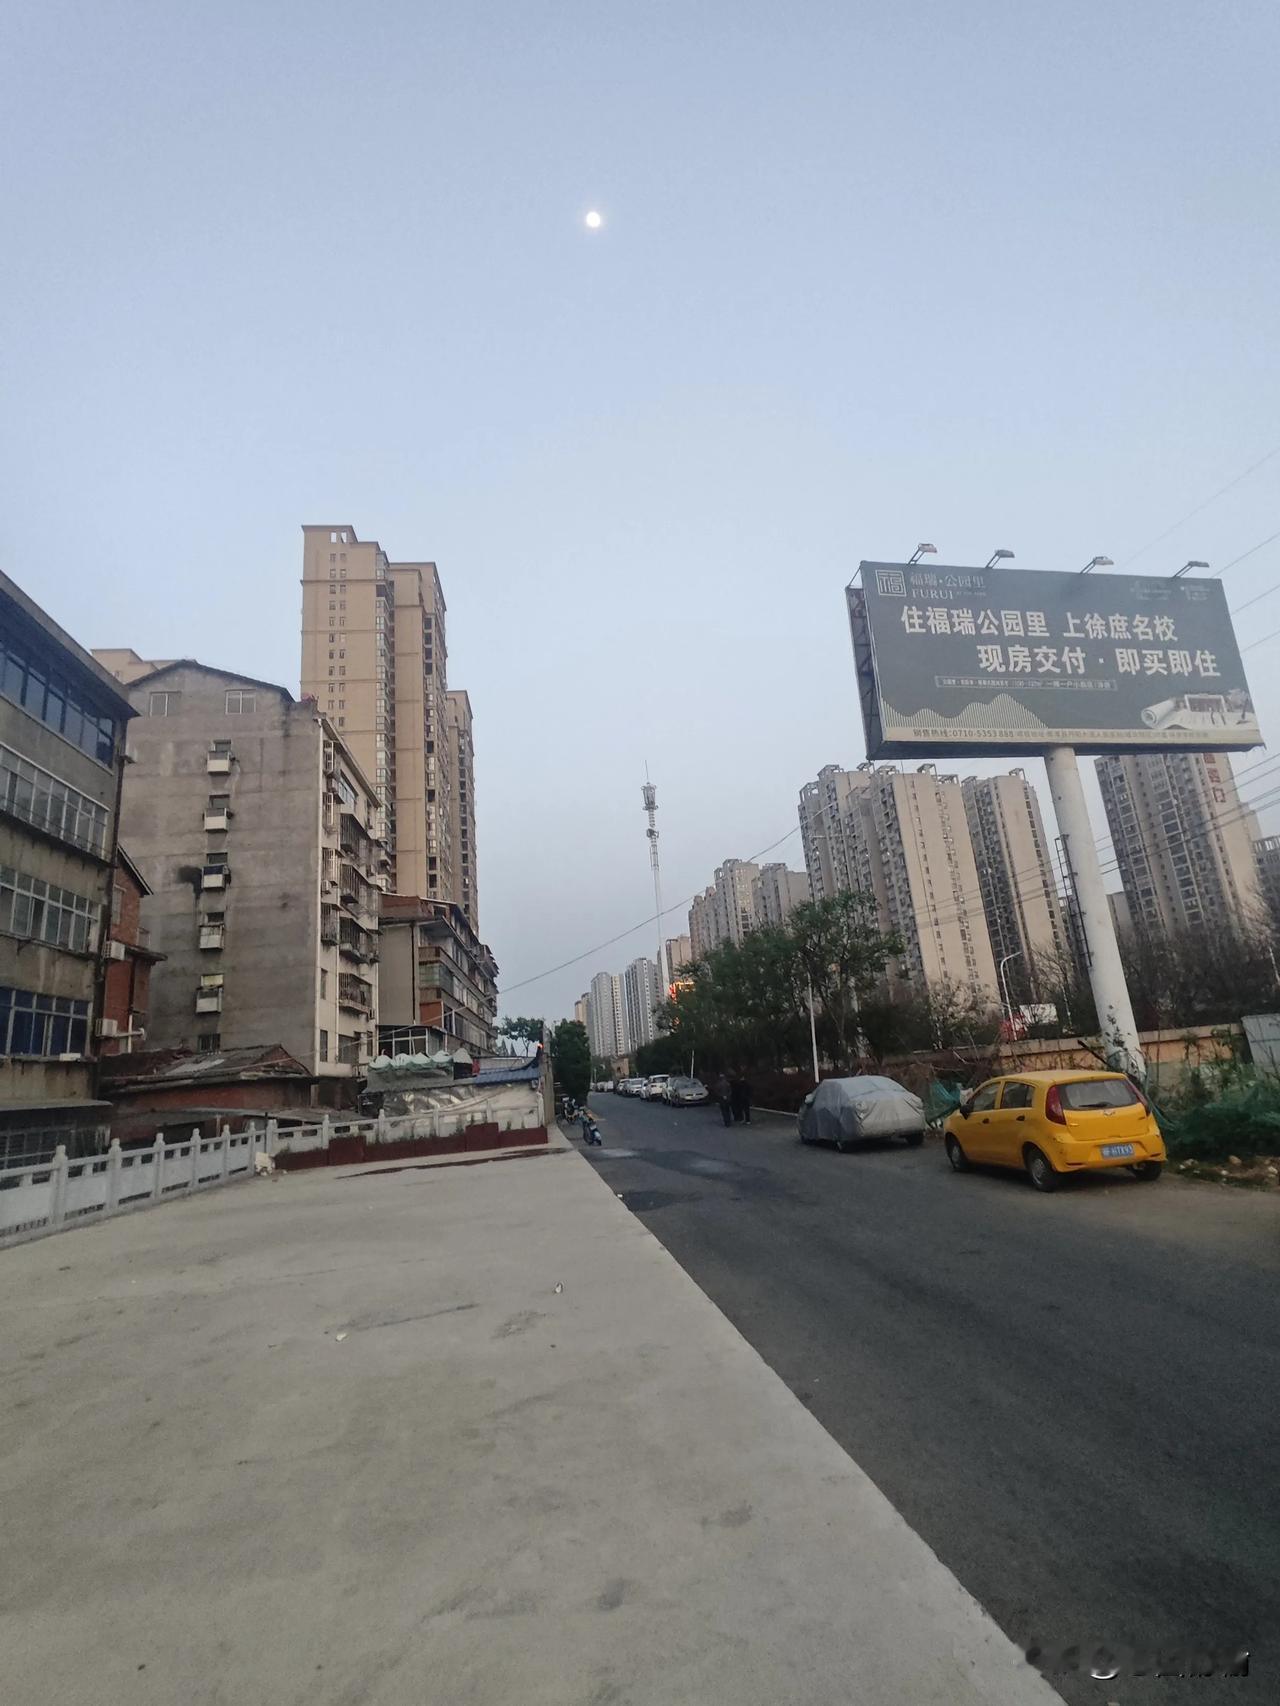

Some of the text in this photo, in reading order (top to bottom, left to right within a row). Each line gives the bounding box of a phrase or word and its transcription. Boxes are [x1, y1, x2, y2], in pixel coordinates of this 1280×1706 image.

[912, 589, 953, 600] FURUI
[901, 605, 1178, 641] 住福瑞公园里 上徐庶名校
